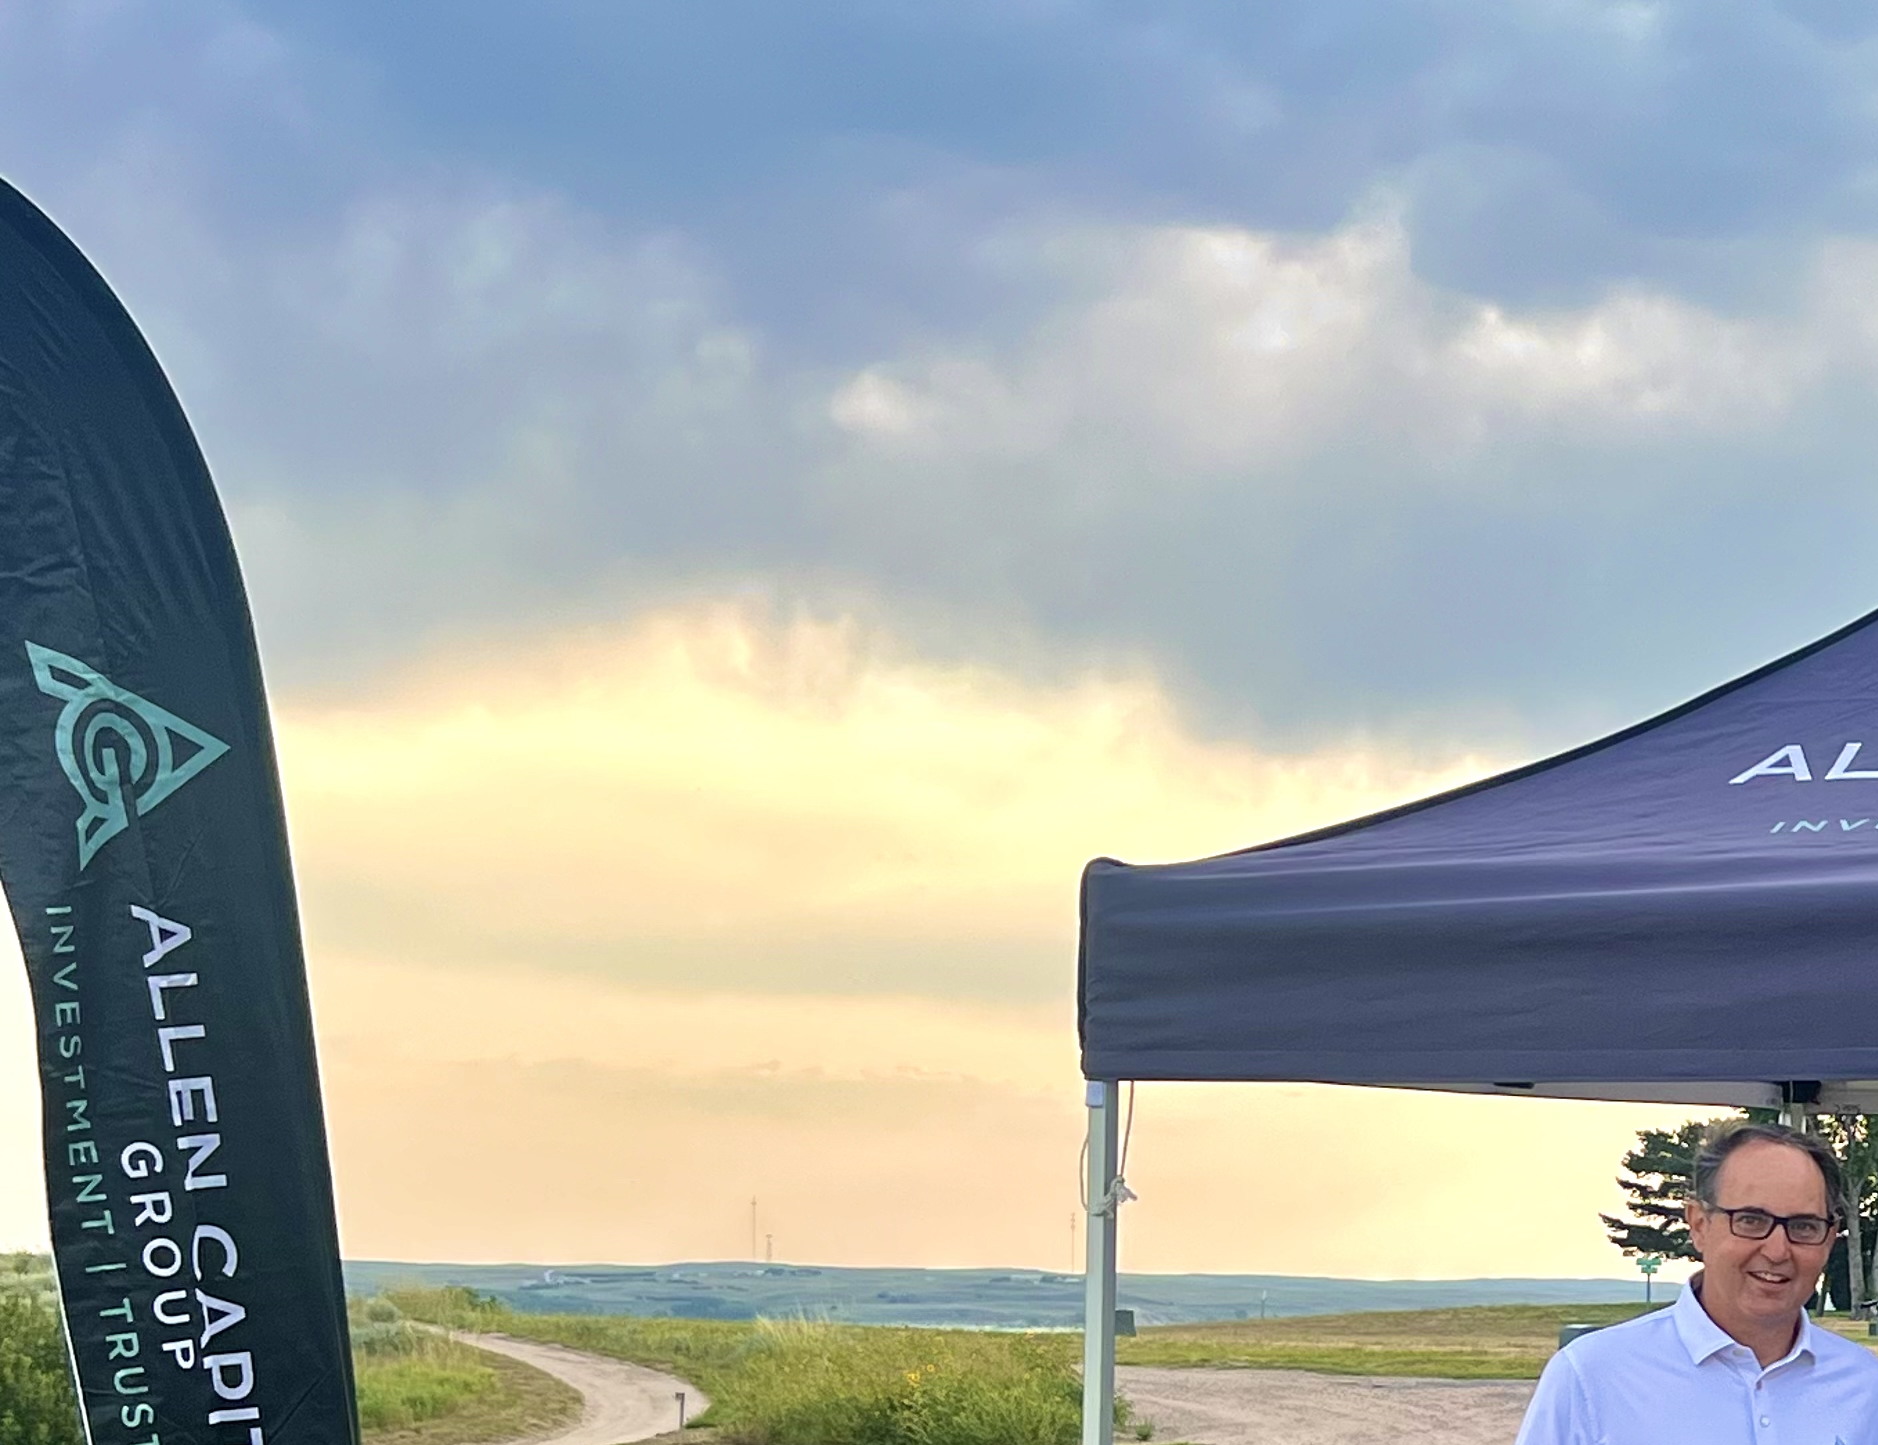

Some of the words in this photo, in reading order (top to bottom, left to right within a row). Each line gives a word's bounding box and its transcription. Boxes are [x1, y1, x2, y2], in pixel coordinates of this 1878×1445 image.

[46, 905, 115, 1235] INVESTMENT
[130, 904, 228, 1191] ALLEN
[120, 1141, 196, 1370] GROUP
